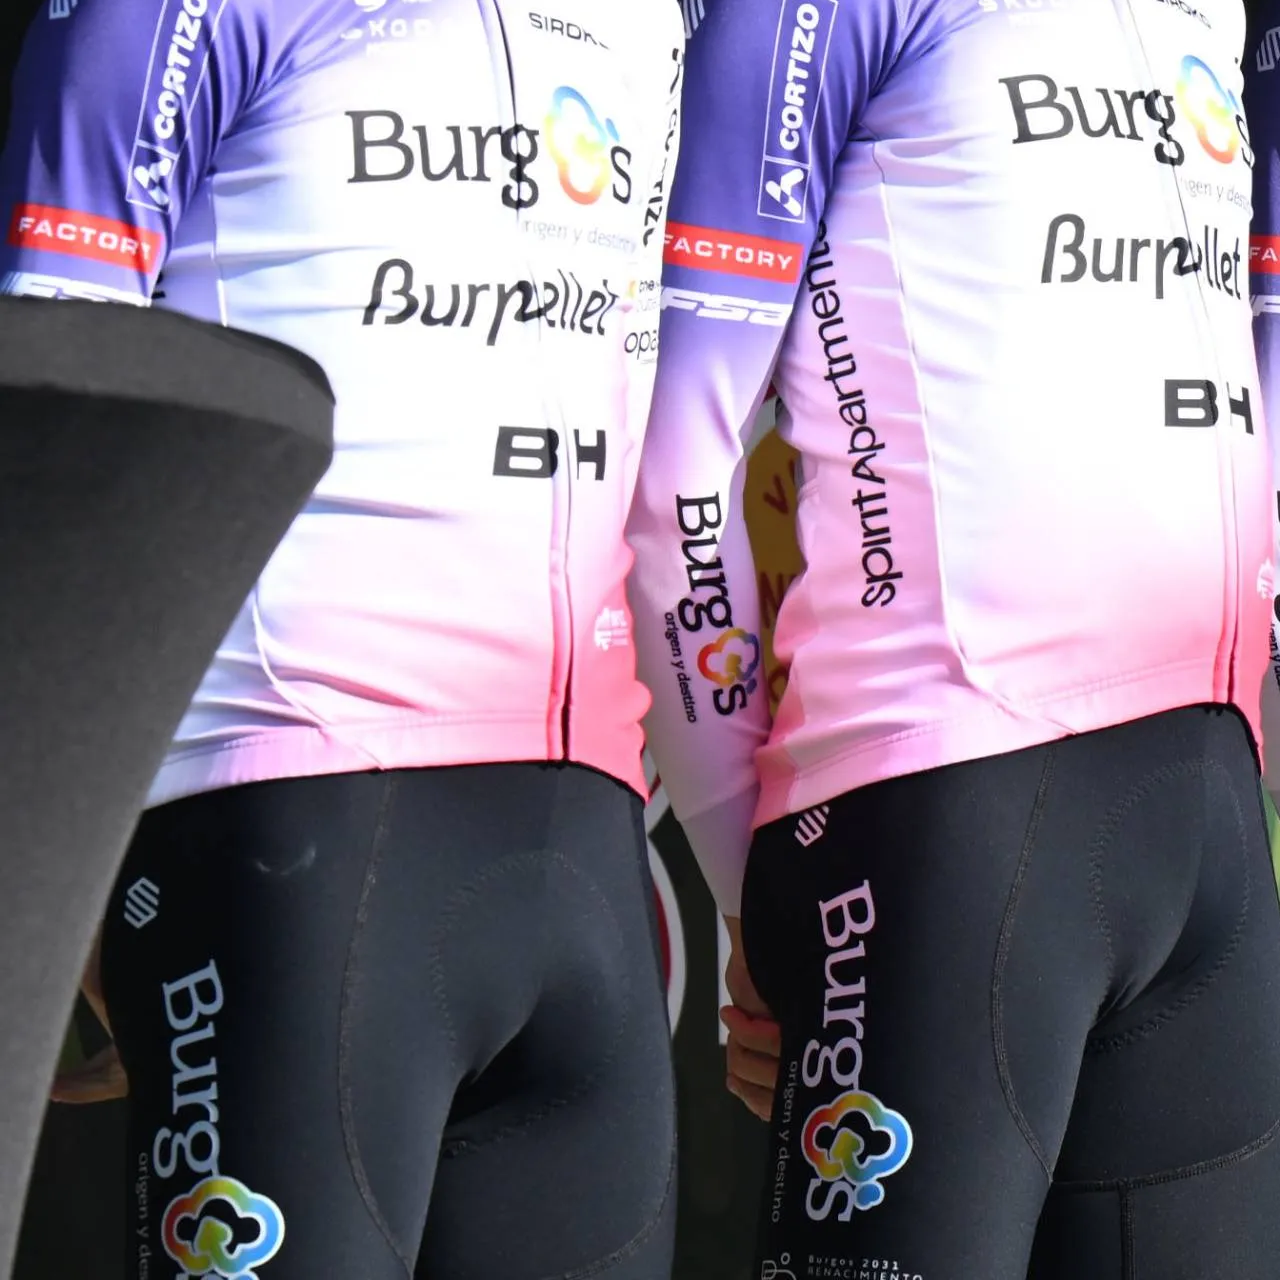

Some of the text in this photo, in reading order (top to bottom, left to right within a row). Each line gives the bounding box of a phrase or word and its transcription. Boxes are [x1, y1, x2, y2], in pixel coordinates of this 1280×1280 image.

[778, 1, 820, 152] CORTIZO
[491, 424, 607, 482] BH
[675, 490, 760, 717] Burgos
[801, 878, 915, 1223] Burgos
[782, 1060, 798, 1126] origen
[778, 1125, 791, 1143] y
[862, 1257, 900, 1271] 2031
